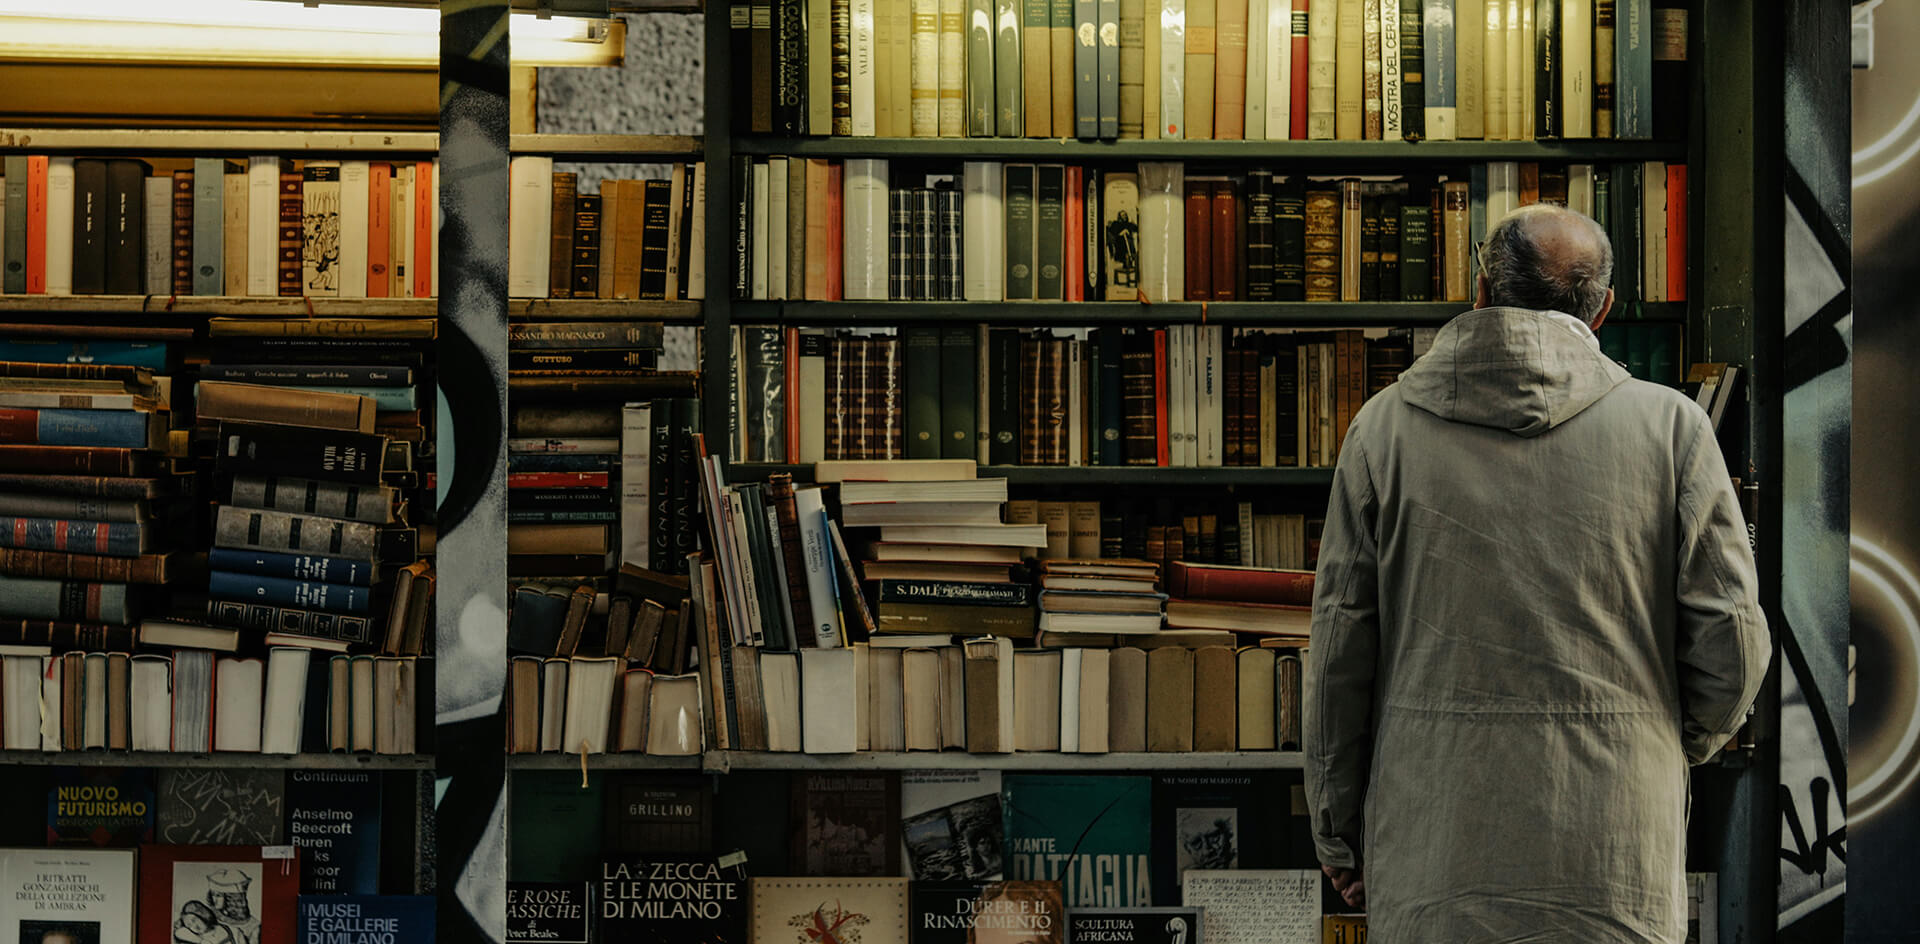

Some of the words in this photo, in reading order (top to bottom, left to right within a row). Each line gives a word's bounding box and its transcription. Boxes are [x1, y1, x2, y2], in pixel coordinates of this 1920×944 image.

[786, 41, 799, 61] DEL
[859, 45, 868, 75] VALLE
[1385, 51, 1397, 76] DEL
[786, 64, 799, 106] MAGO
[1386, 79, 1398, 131] MOSTRA
[737, 253, 745, 289] Francesco
[283, 322, 366, 337] LECCO
[510, 331, 555, 341] ESSANDRO
[555, 331, 606, 341] MAGNASCO
[532, 355, 573, 364] GUTTUSO
[343, 447, 356, 471] STORIA
[896, 584, 907, 595] S.
[293, 770, 368, 783] Continuum
[58, 786, 119, 801] NUOVO
[57, 801, 147, 817] FUTURISMO
[292, 808, 354, 821] Anselmo
[629, 804, 693, 817] GRILLINO
[292, 822, 352, 835] Beecroft
[292, 836, 333, 848] Buren
[1013, 838, 1056, 853] XANTE
[42, 874, 87, 883] RITRATTI
[603, 863, 631, 881] LA
[649, 863, 721, 881] ZECCA
[16, 892, 45, 901] DELLA
[47, 892, 106, 901] COLLEZIONE
[507, 889, 518, 904] E
[524, 889, 571, 904] ROSE
[603, 882, 616, 900] E
[620, 882, 643, 900] LE
[647, 882, 738, 900] MONETE
[34, 902, 44, 911] DI
[47, 902, 88, 911] AMBRAS
[307, 903, 361, 917] MUSEI
[506, 904, 582, 919] ASSICHE
[603, 901, 624, 919] DI
[631, 901, 722, 919] MILANO
[956, 897, 1016, 914] DÜRER
[1020, 900, 1030, 914] E
[1035, 900, 1051, 914] IL
[307, 918, 319, 932] E
[321, 918, 399, 932] GALLERIE
[923, 912, 1052, 929] RINASCIMENTO
[1075, 919, 1134, 931] SCULTURA
[307, 932, 328, 944] DI
[330, 932, 395, 944] MILANO
[508, 929, 529, 940] eter
[530, 929, 559, 939] Beales
[1075, 931, 1135, 942] AFRICANA
